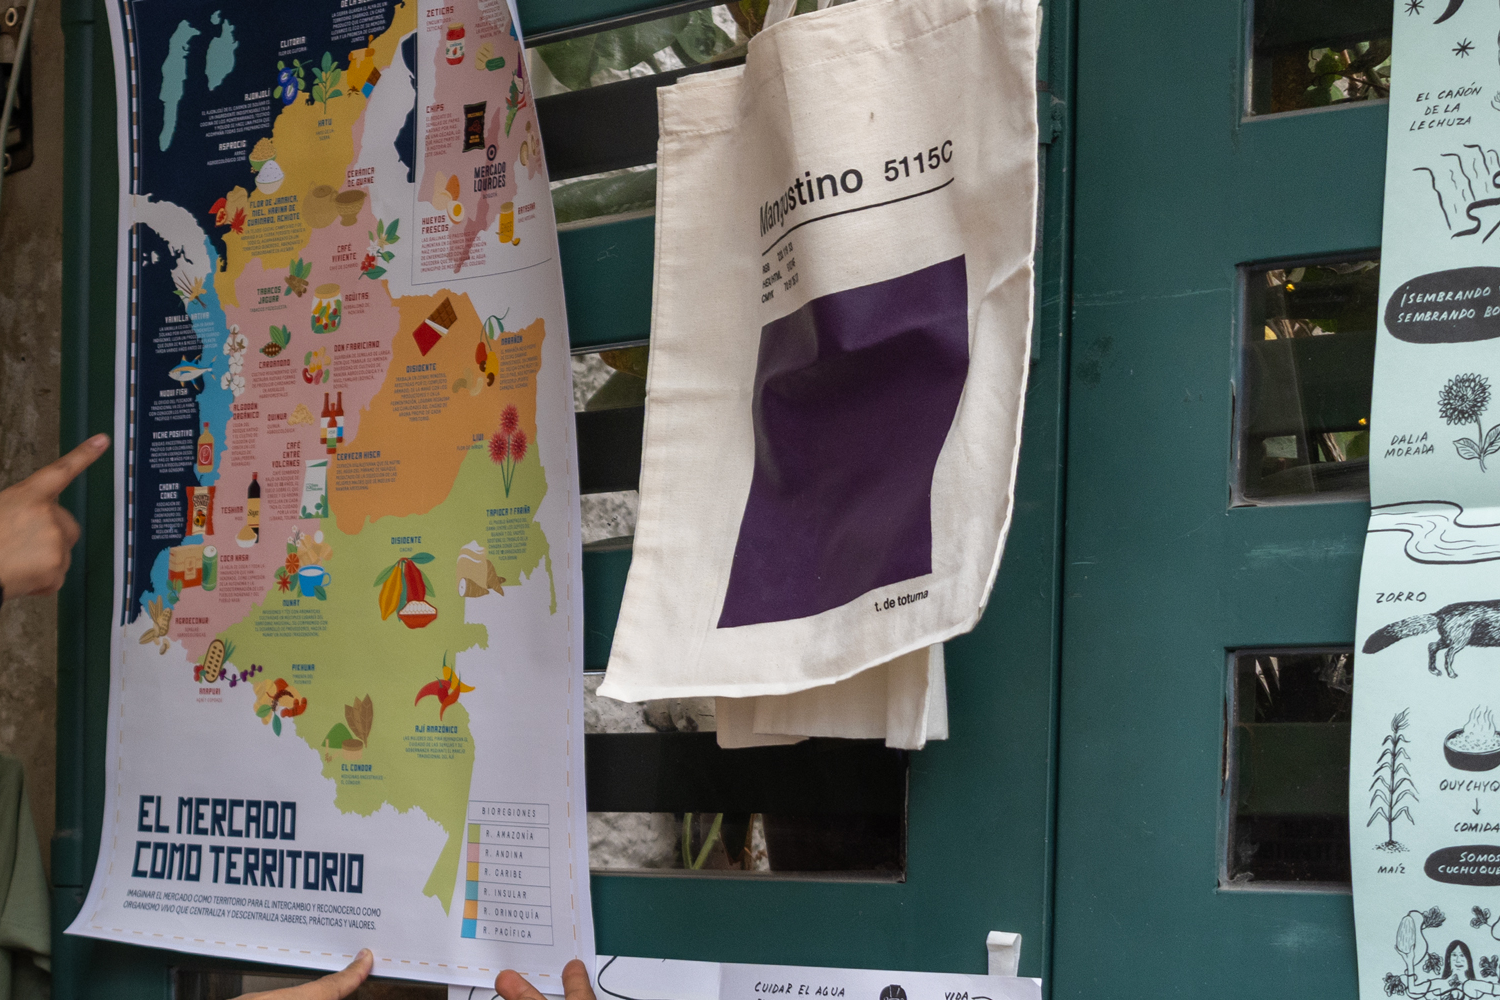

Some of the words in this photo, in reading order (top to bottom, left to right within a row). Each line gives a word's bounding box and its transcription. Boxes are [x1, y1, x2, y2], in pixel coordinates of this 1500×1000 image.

[1416, 92, 1430, 102] EL
[1438, 82, 1482, 100] CAÑÓN
[1424, 104, 1439, 115] DE
[1444, 103, 1460, 113] LA
[1409, 116, 1471, 131] LECHUZA
[884, 139, 953, 182] 5115C
[473, 162, 507, 179] MERCADO
[473, 176, 507, 193] LOURDES
[421, 215, 446, 226] HUEVOS
[421, 224, 449, 235] FRESCOS
[1401, 286, 1492, 307] ¡SEMBRANDO
[1397, 308, 1476, 323] SEMBRANDO
[406, 363, 437, 373] DISIDENTE
[1391, 432, 1428, 446] DALIA
[1384, 444, 1435, 459] MORADA
[391, 536, 422, 545] DISIDENTE
[875, 602, 882, 612] t.
[884, 598, 895, 610] de
[897, 590, 928, 606] totuma
[1376, 591, 1427, 604] ZORRO
[341, 764, 349, 772] EL
[137, 794, 170, 833] EL
[175, 796, 296, 841] MERCADO
[482, 807, 536, 818] BIOREGIONES
[1454, 822, 1500, 833] COMIDA
[486, 830, 493, 838] R.
[496, 829, 534, 840] AMAZONÍA
[485, 849, 492, 857] R.
[496, 849, 523, 859] ANDINA
[1459, 852, 1500, 863] SOMOS
[131, 840, 202, 882] COMO
[209, 844, 365, 894] TERRITORIO
[484, 868, 491, 876] R.
[495, 868, 522, 879] CARIBE
[1377, 863, 1406, 874] MAÍZ
[484, 888, 490, 896] R.
[494, 889, 527, 899] INSULAR
[484, 907, 490, 916] R.
[494, 907, 540, 920] ORINOQUÍA
[483, 926, 490, 935] R.
[495, 926, 532, 939] PACÍFICA
[754, 980, 794, 995] CUIDAR
[798, 983, 810, 996] EL
[815, 985, 845, 998] AGUA
